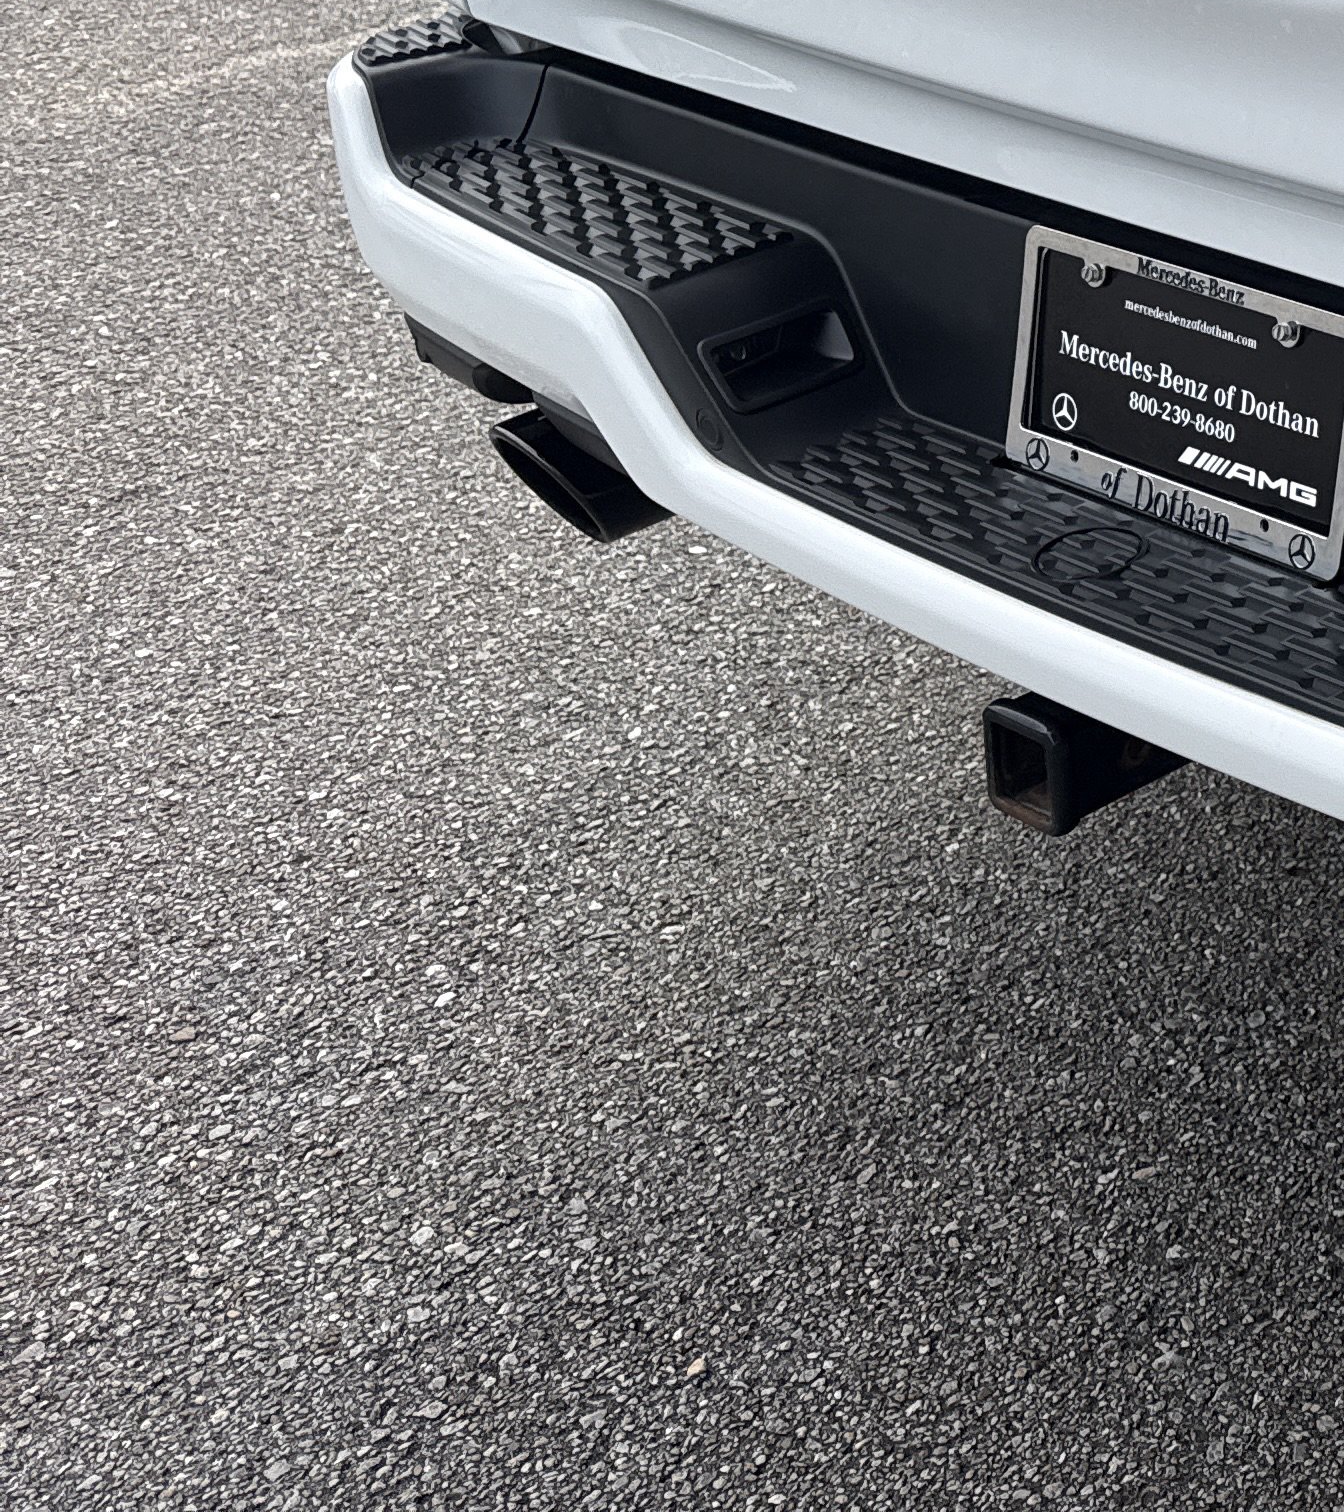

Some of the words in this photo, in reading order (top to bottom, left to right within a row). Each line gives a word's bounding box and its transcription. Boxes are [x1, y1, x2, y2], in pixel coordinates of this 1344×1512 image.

[1137, 256, 1246, 306] Mercedes-Benz
[1124, 298, 1258, 350] mercedesbenzofdothan.com
[1059, 330, 1208, 402] Mercedes-Benz
[1214, 383, 1236, 411] of
[1239, 389, 1320, 439] Dothan
[1129, 391, 1236, 443] 800-239-8680
[1101, 467, 1127, 500] of
[1133, 471, 1231, 544] Dothan
